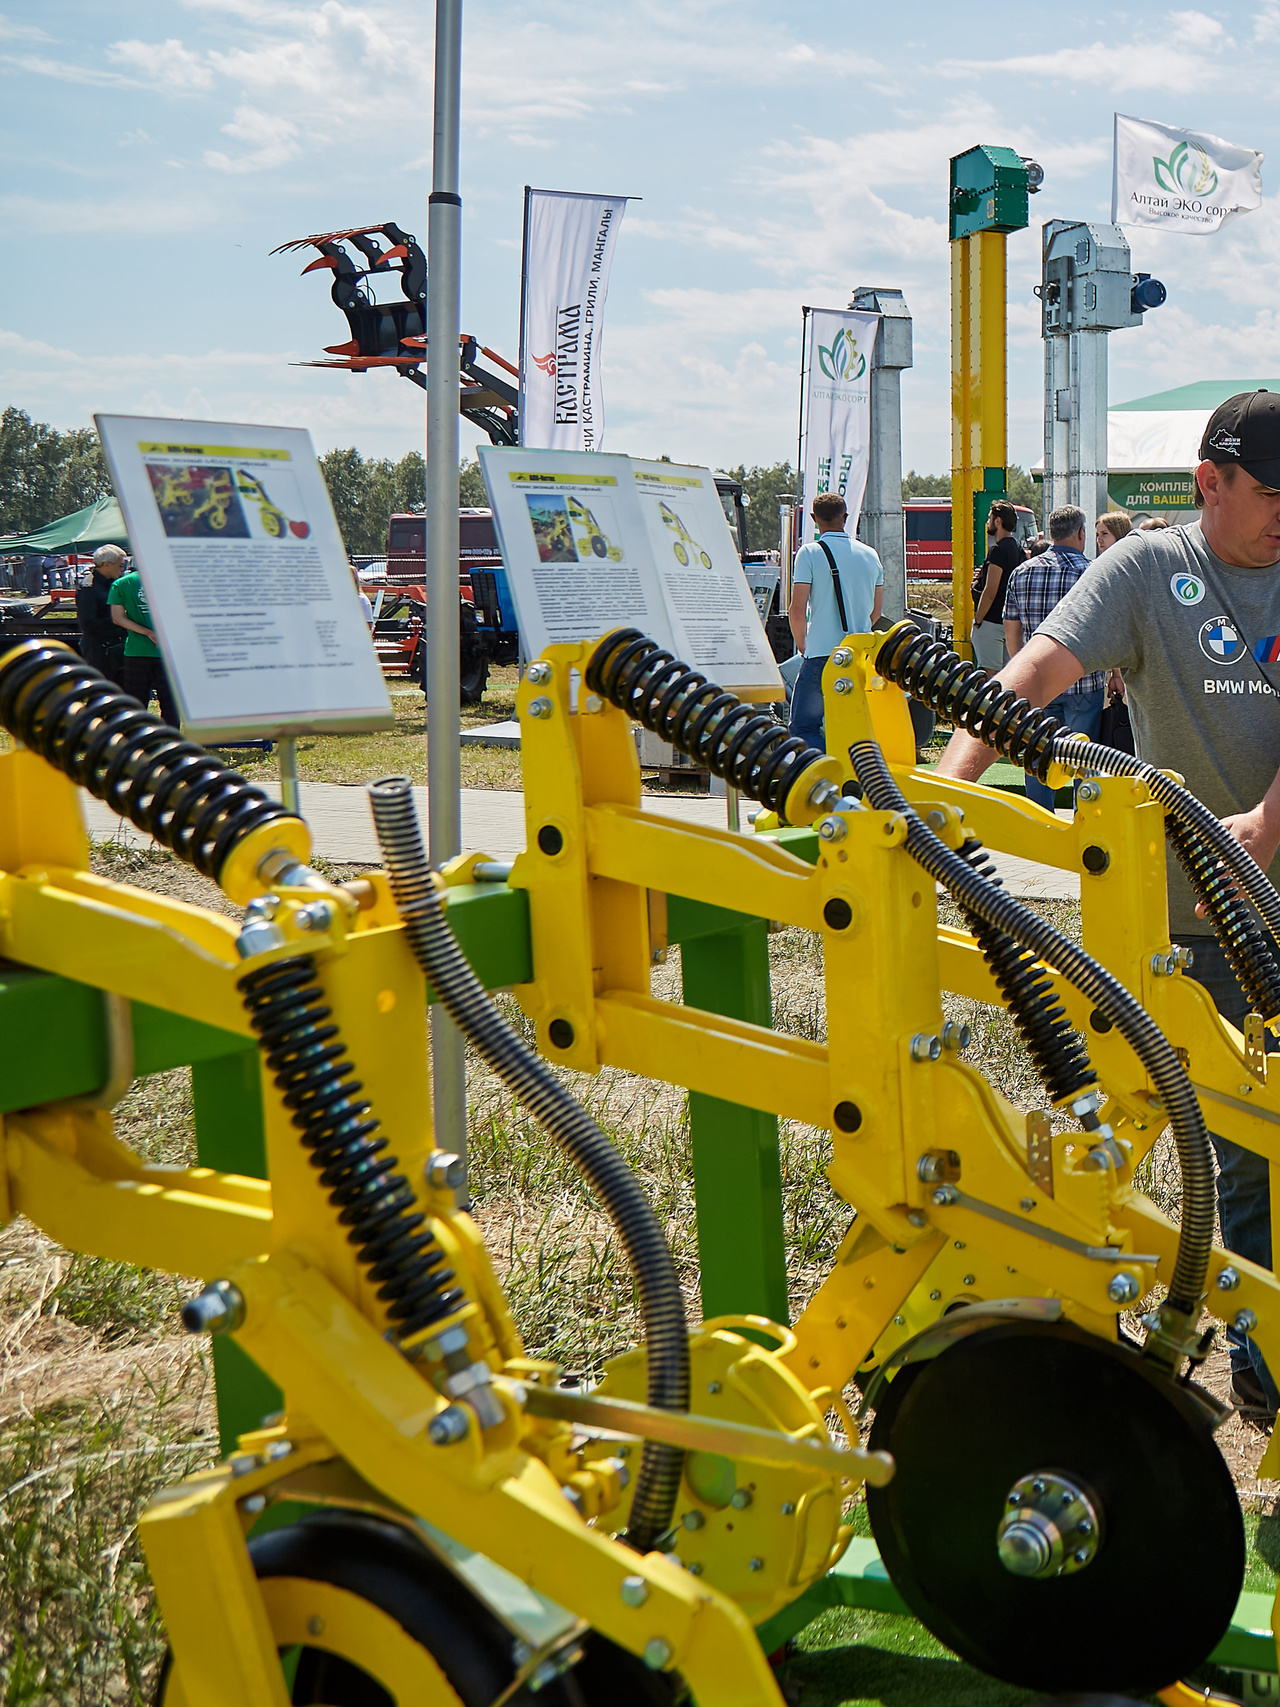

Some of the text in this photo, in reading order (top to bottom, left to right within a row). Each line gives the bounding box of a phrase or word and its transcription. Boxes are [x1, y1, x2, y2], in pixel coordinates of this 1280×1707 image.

[1130, 191, 1231, 219] Алтай ЭКО сор
[1149, 207, 1214, 224] Высокое качество
[591, 208, 614, 272] МАНГАЛЫ
[585, 276, 601, 324] ГРИЛИ,
[555, 304, 581, 424] КАСТРАМА
[582, 327, 594, 424] КАСТРАМИНА,
[847, 394, 868, 404] СОРТ
[1125, 495, 1150, 506] ДЛЯ
[1203, 679, 1245, 694] BMW
